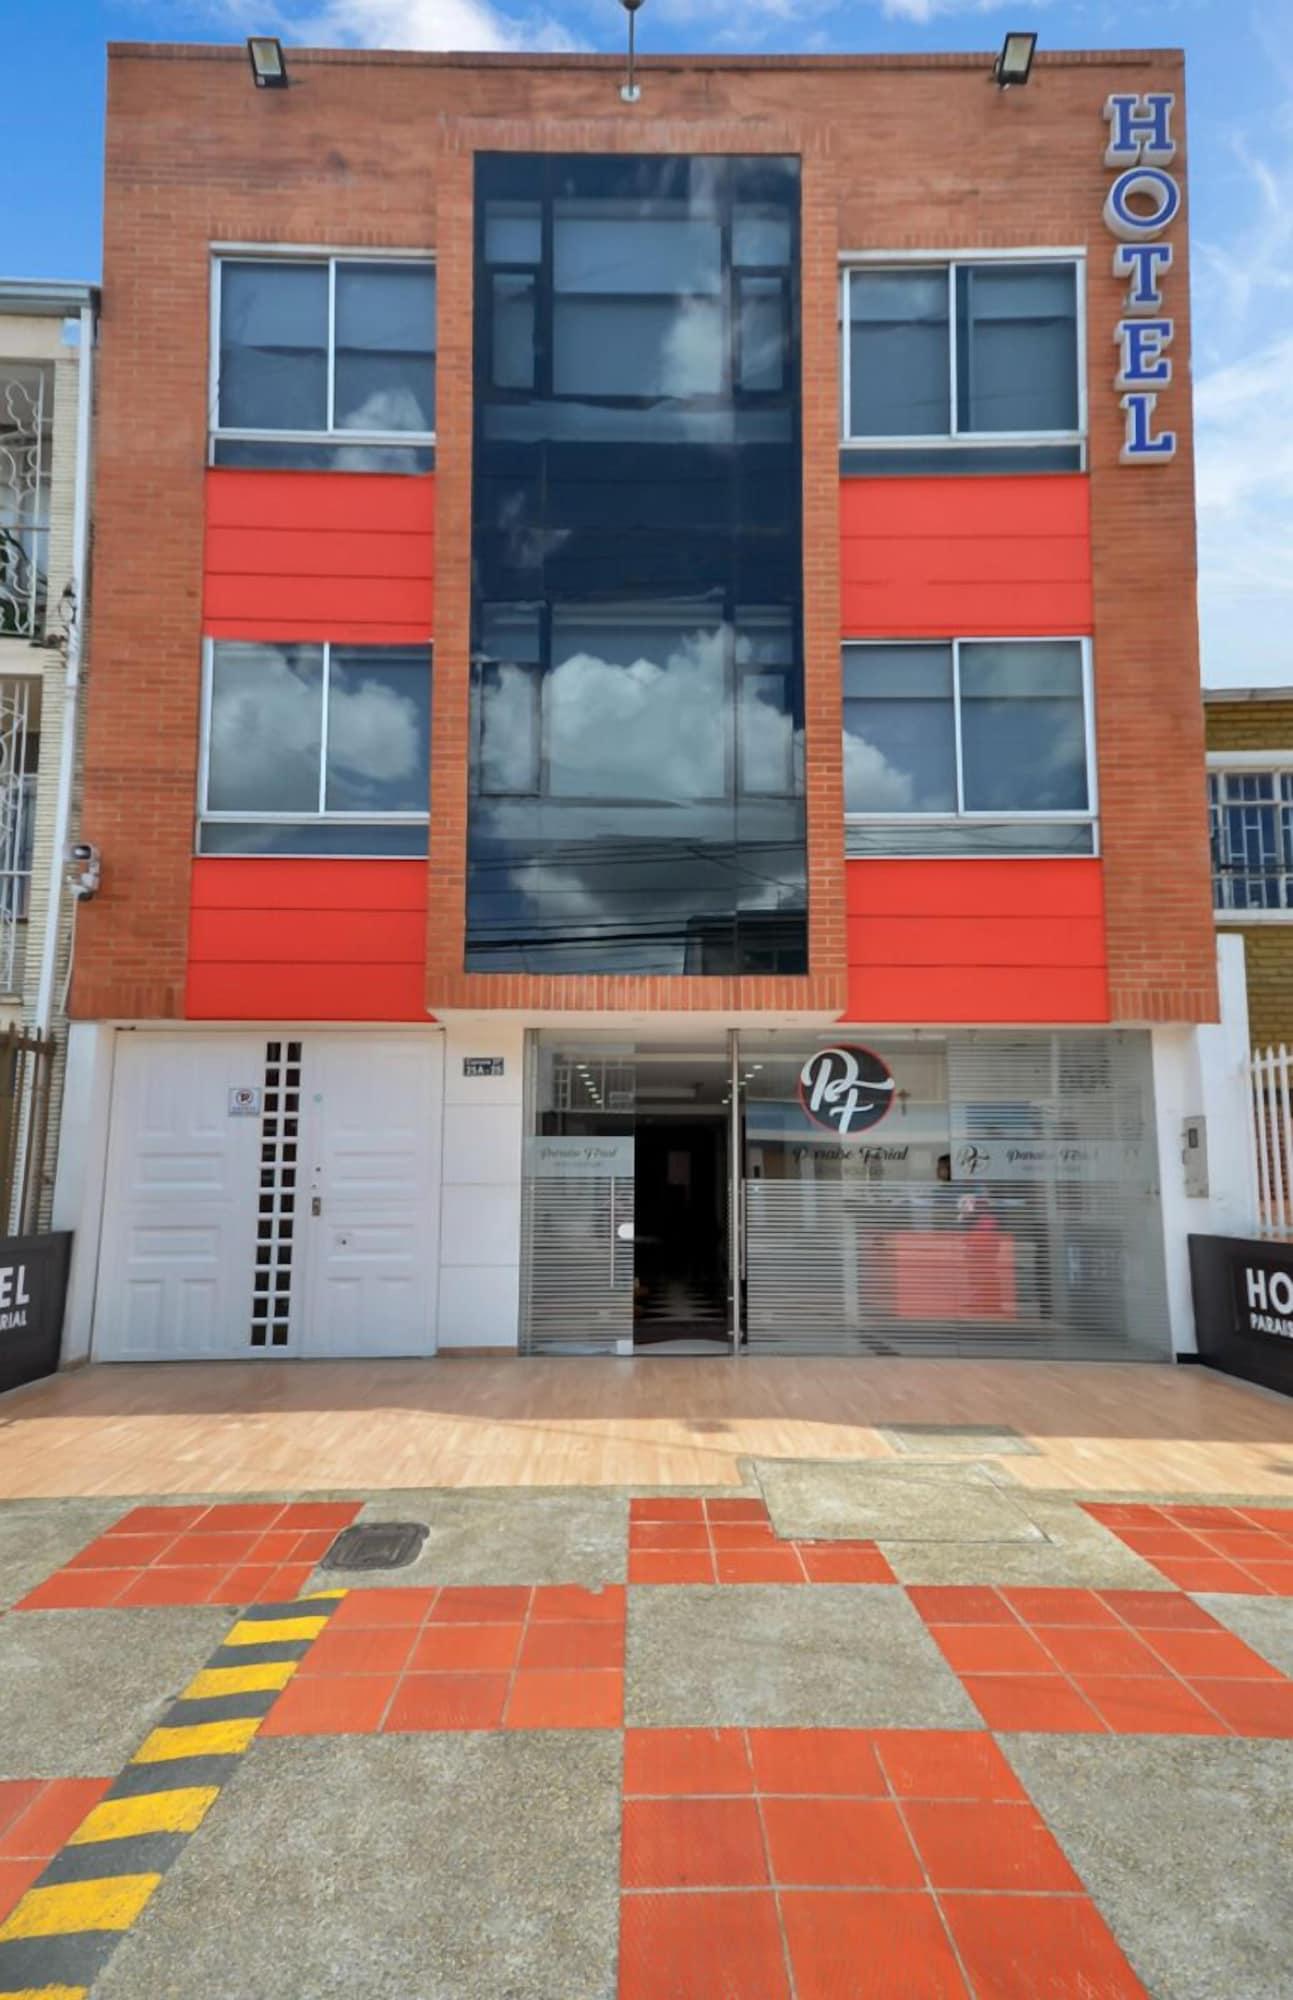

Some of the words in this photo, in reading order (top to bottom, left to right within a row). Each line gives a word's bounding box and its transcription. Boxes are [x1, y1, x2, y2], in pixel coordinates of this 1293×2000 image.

[1103, 93, 1181, 464] HOTEL
[0, 1265, 30, 1308] EL
[1246, 1268, 1293, 1315] HO
